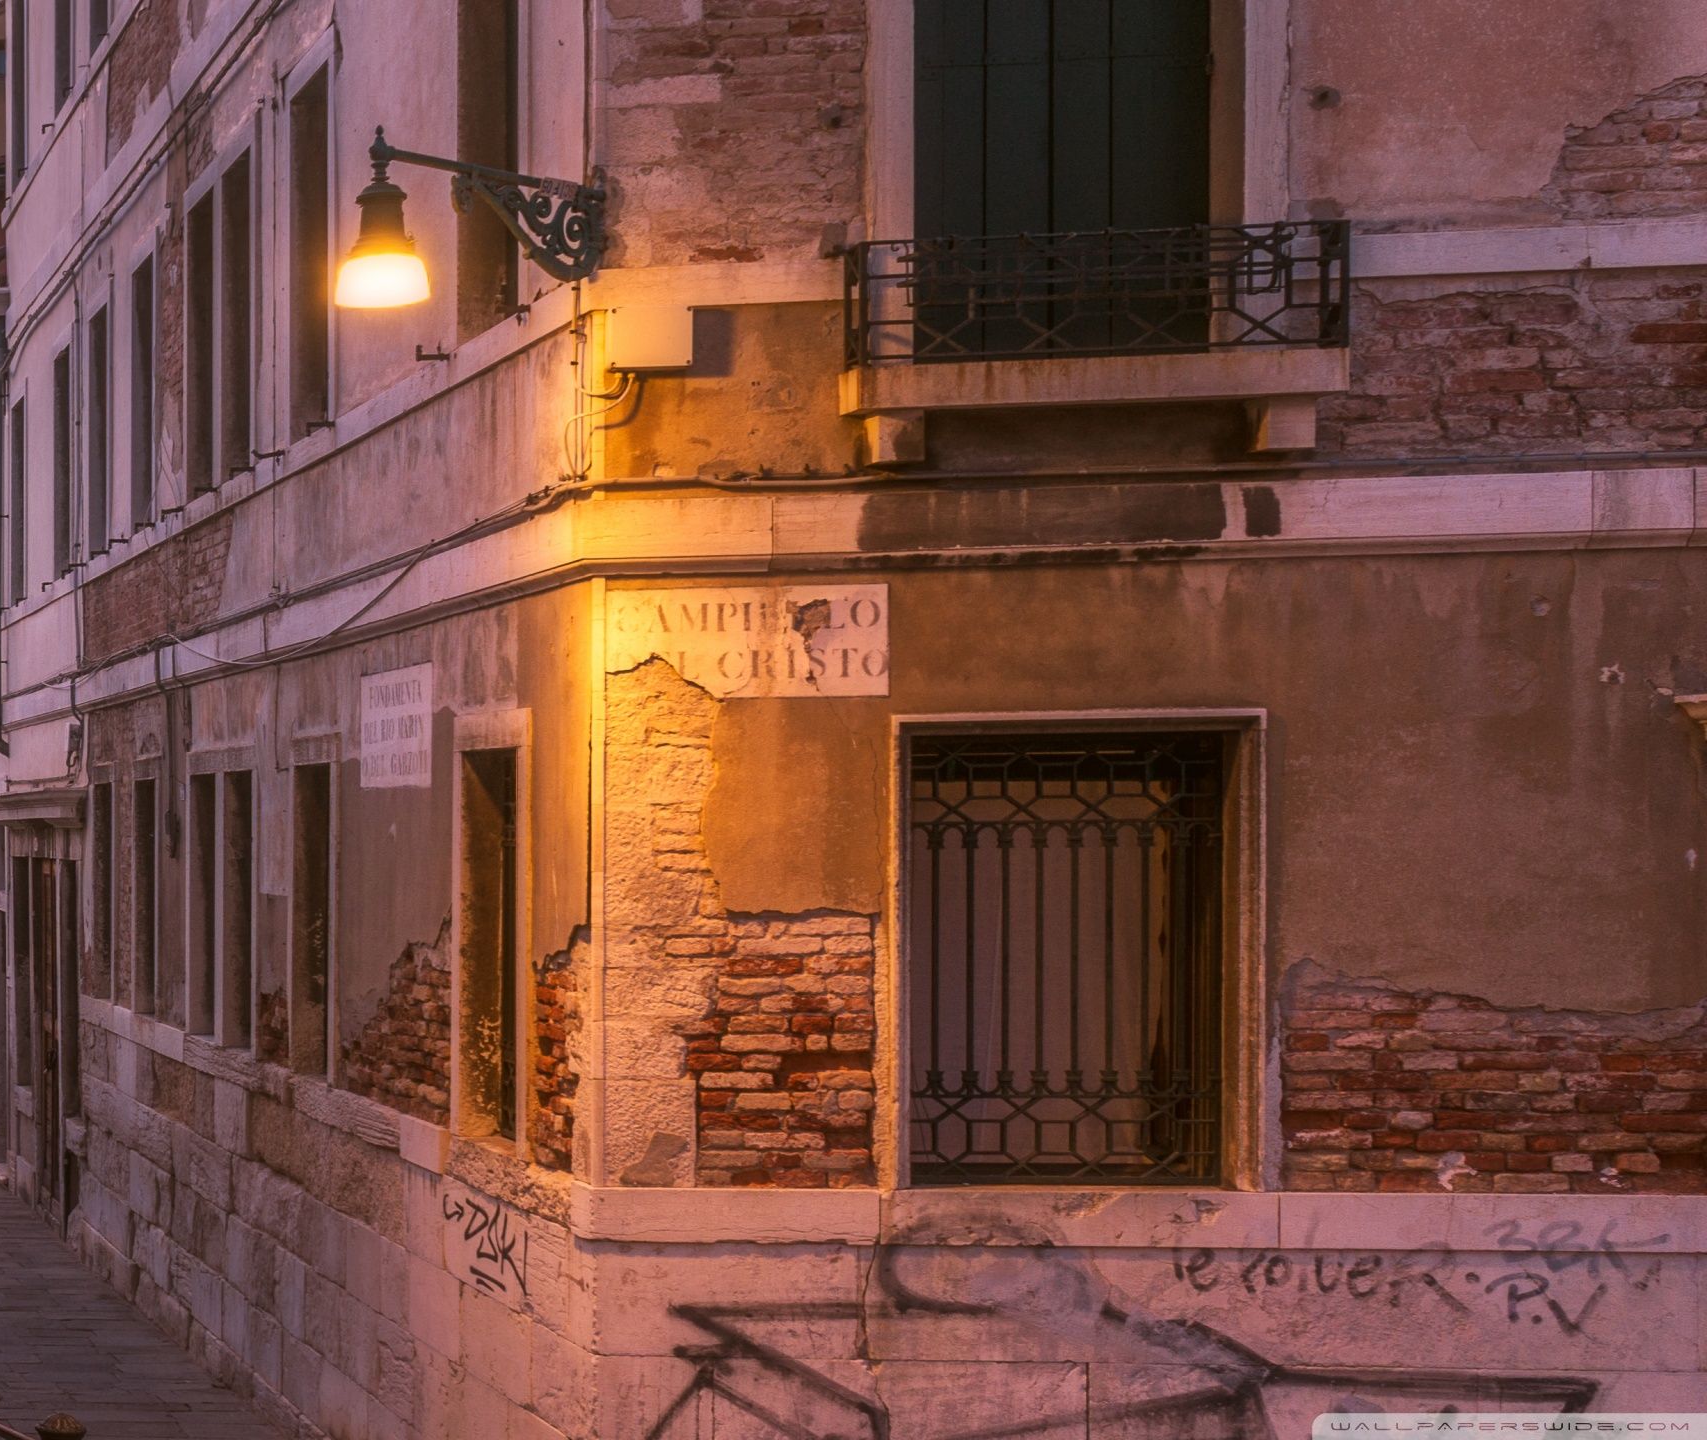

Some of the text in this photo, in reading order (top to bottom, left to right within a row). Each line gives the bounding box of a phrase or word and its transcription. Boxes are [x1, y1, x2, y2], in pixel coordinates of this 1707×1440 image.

[717, 648, 887, 679] CRISTO
[369, 679, 423, 709] FONDAMENTA
[380, 718, 395, 742] RIO
